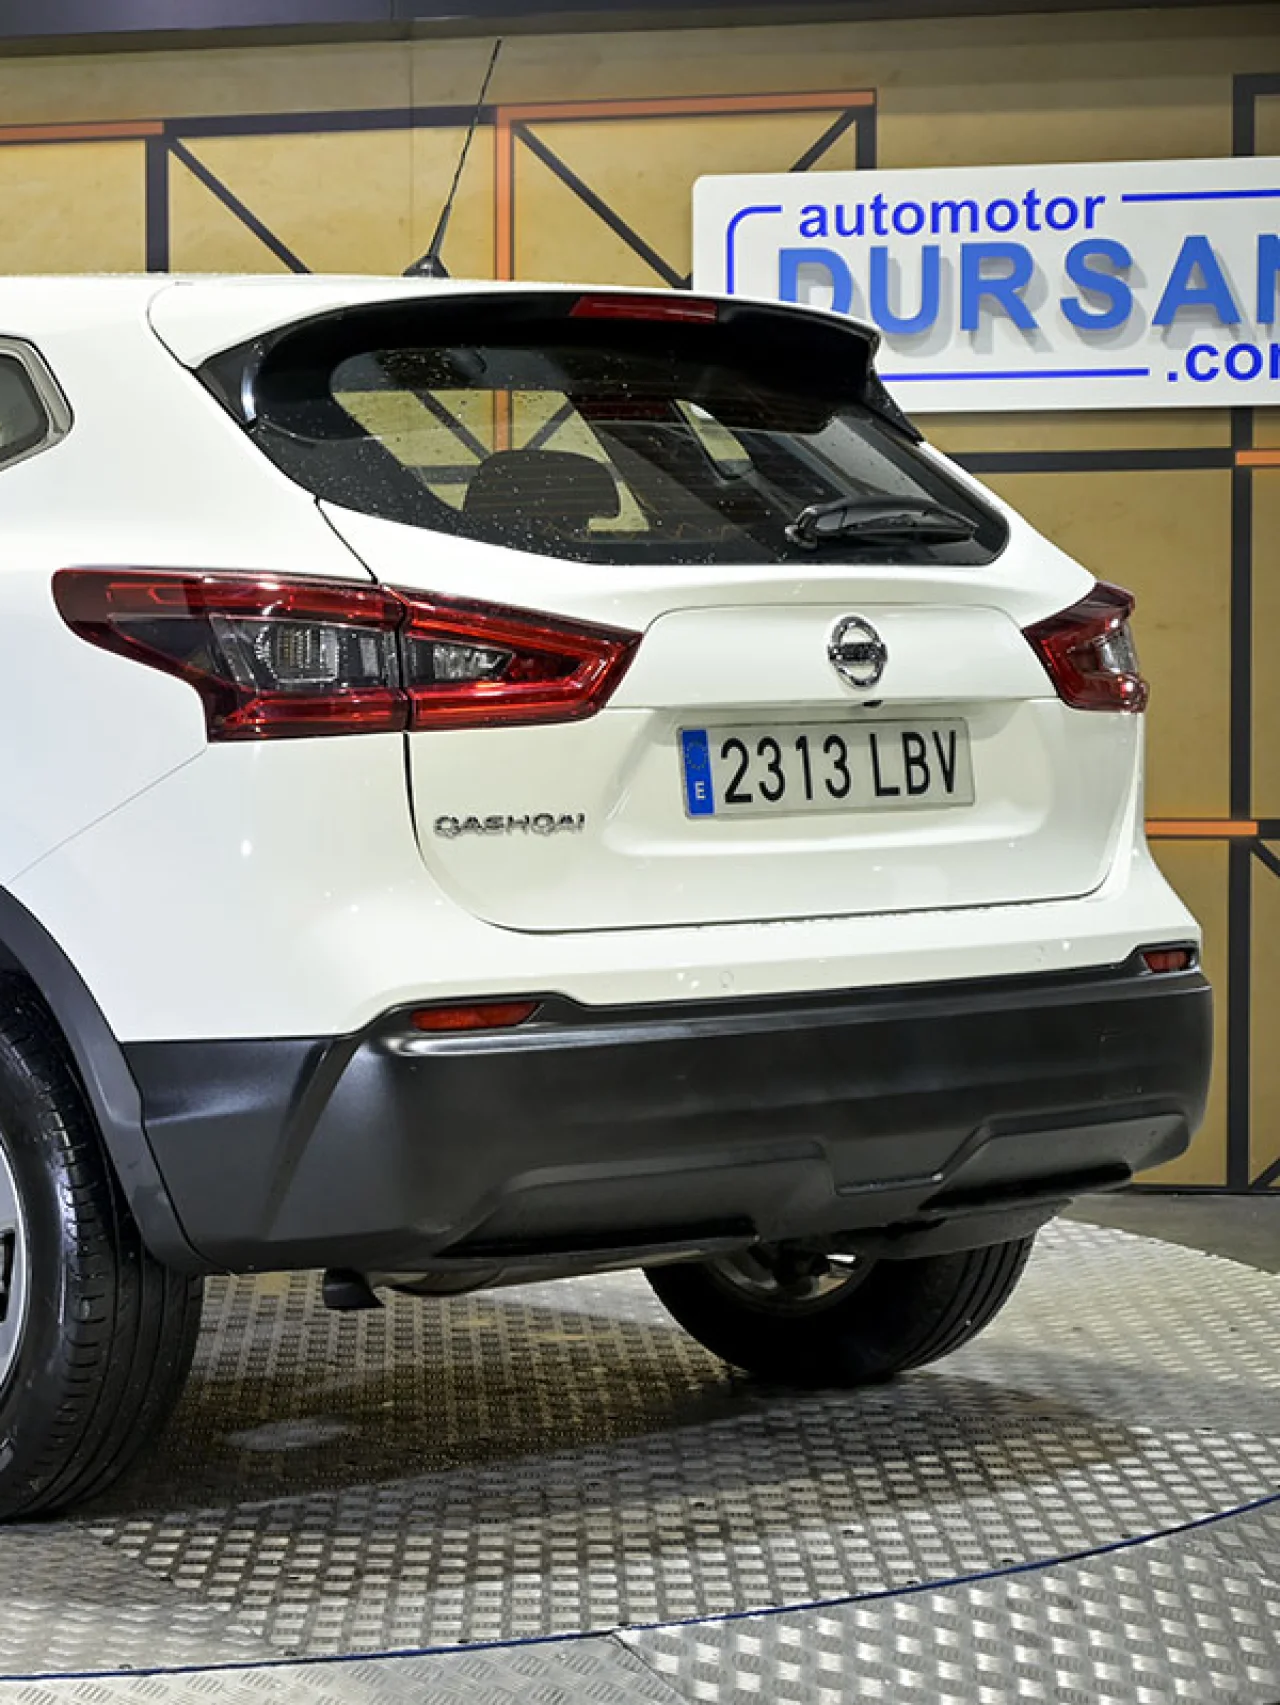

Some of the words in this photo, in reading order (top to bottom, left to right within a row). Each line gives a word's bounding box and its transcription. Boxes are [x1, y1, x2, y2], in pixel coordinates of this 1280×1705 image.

[798, 188, 1106, 238] automotor
[1166, 342, 1280, 382] .co
[720, 733, 852, 804] 2313
[869, 729, 957, 798] LBV
[694, 780, 706, 800] E
[433, 812, 586, 840] QASHQAI
